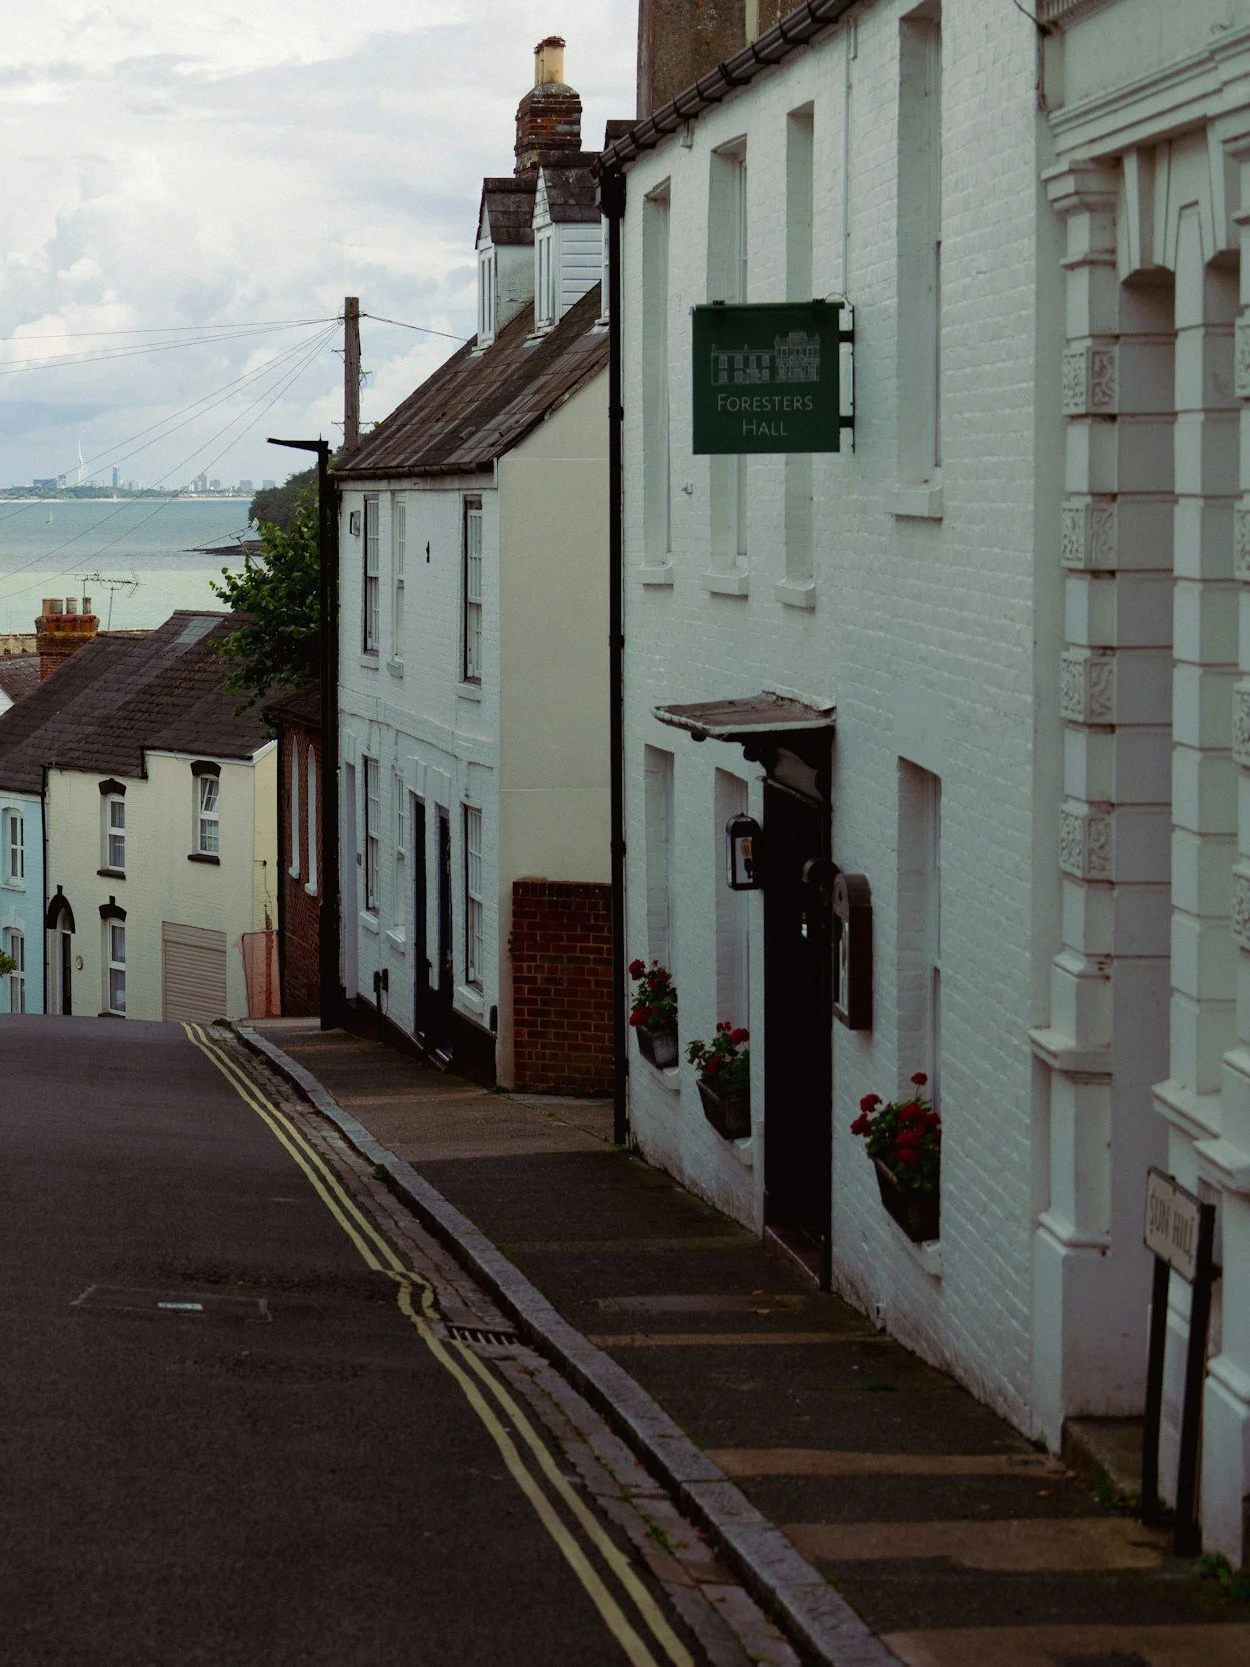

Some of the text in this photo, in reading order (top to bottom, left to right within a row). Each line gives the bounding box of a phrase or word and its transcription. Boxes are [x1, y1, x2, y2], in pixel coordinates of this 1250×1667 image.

[717, 393, 813, 412] FORESTERS
[742, 418, 788, 436] HALL
[1172, 1209, 1195, 1264] HILL
